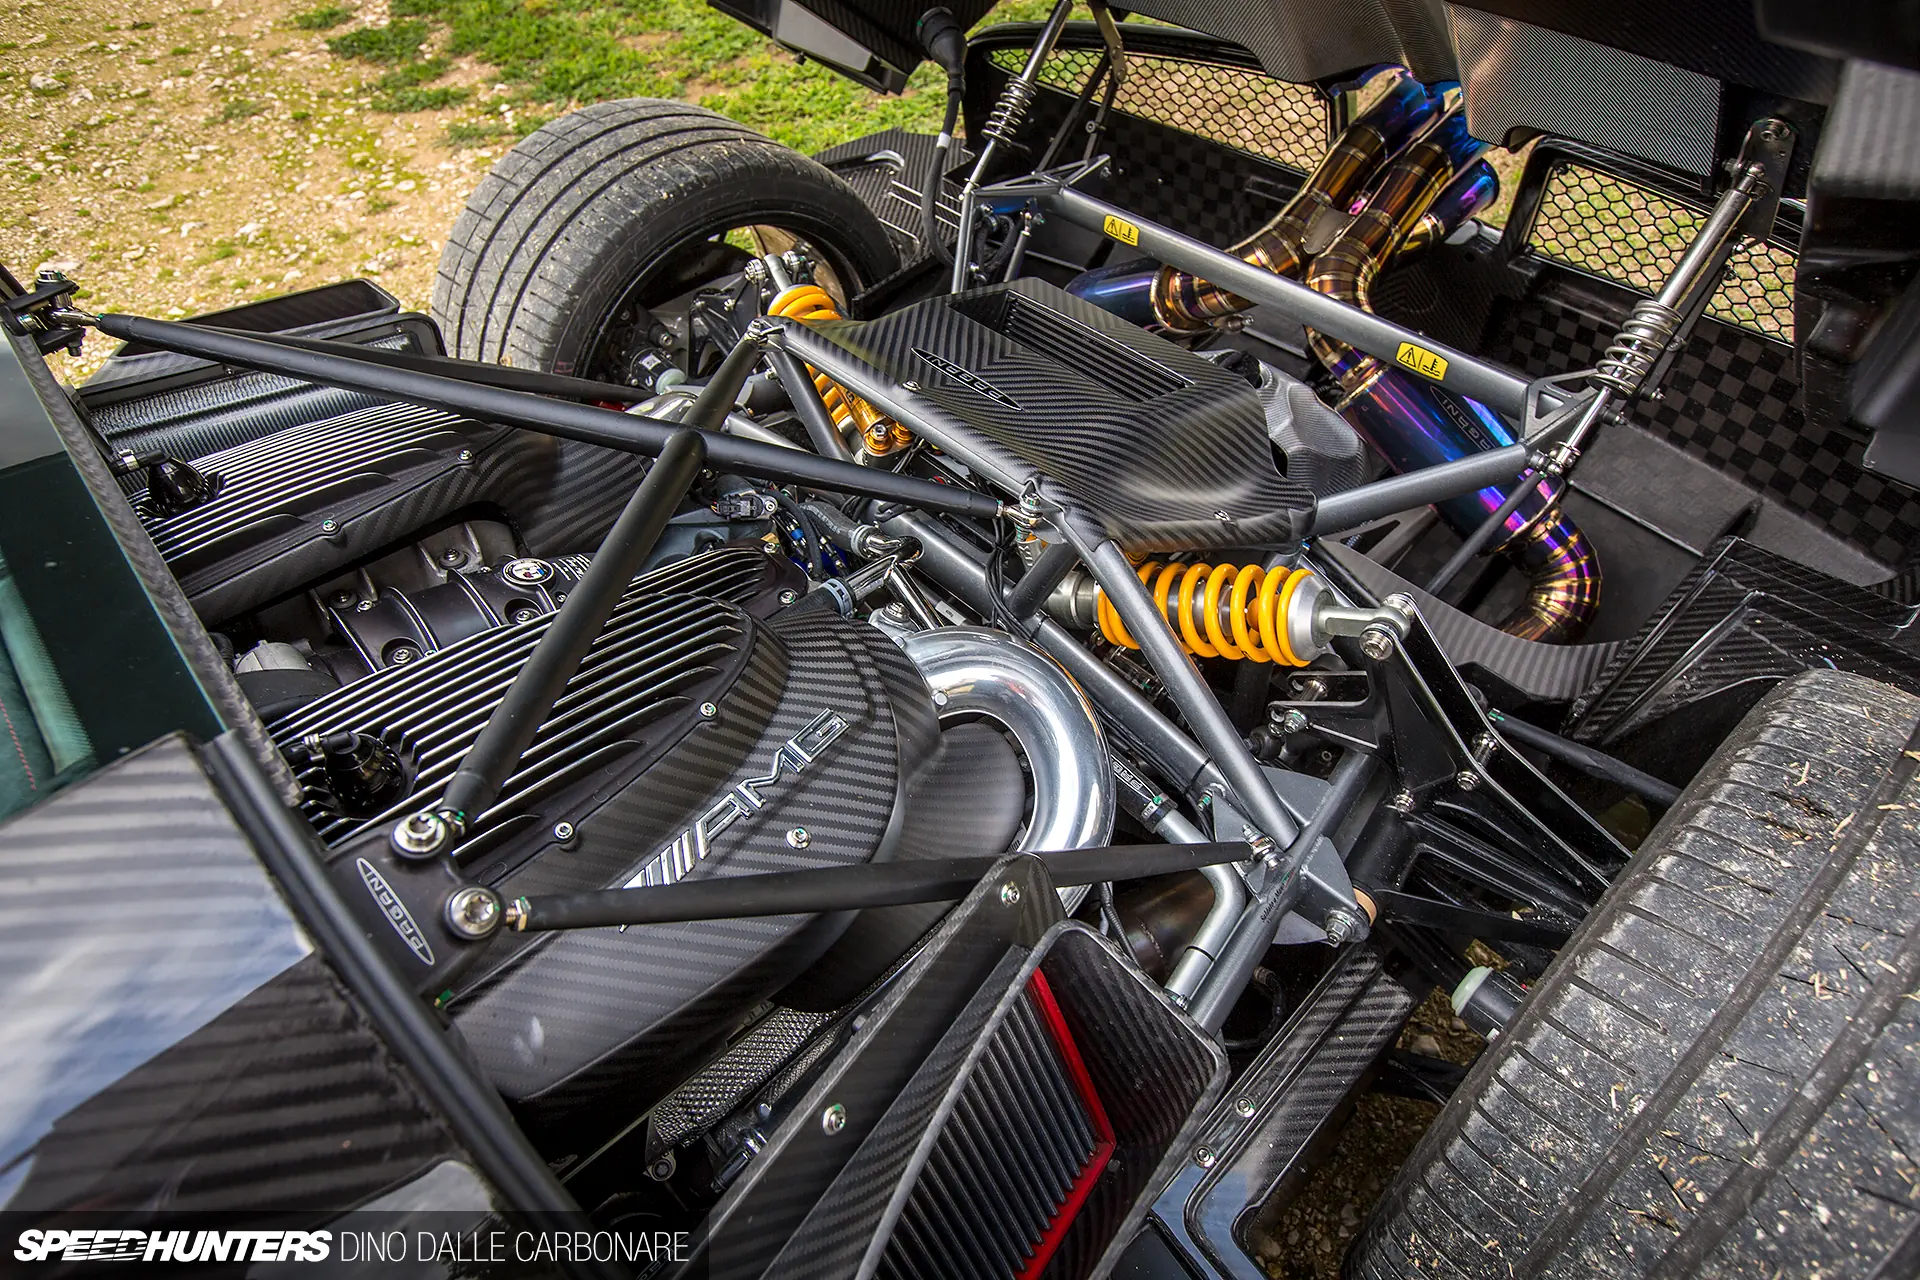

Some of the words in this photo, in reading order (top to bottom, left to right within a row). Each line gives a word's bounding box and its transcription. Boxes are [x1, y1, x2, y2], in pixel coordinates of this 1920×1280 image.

[925, 354, 1005, 400] PAGANI
[1442, 397, 1493, 452] AGANI
[695, 707, 852, 861] AMG
[365, 870, 424, 951] PAGANI
